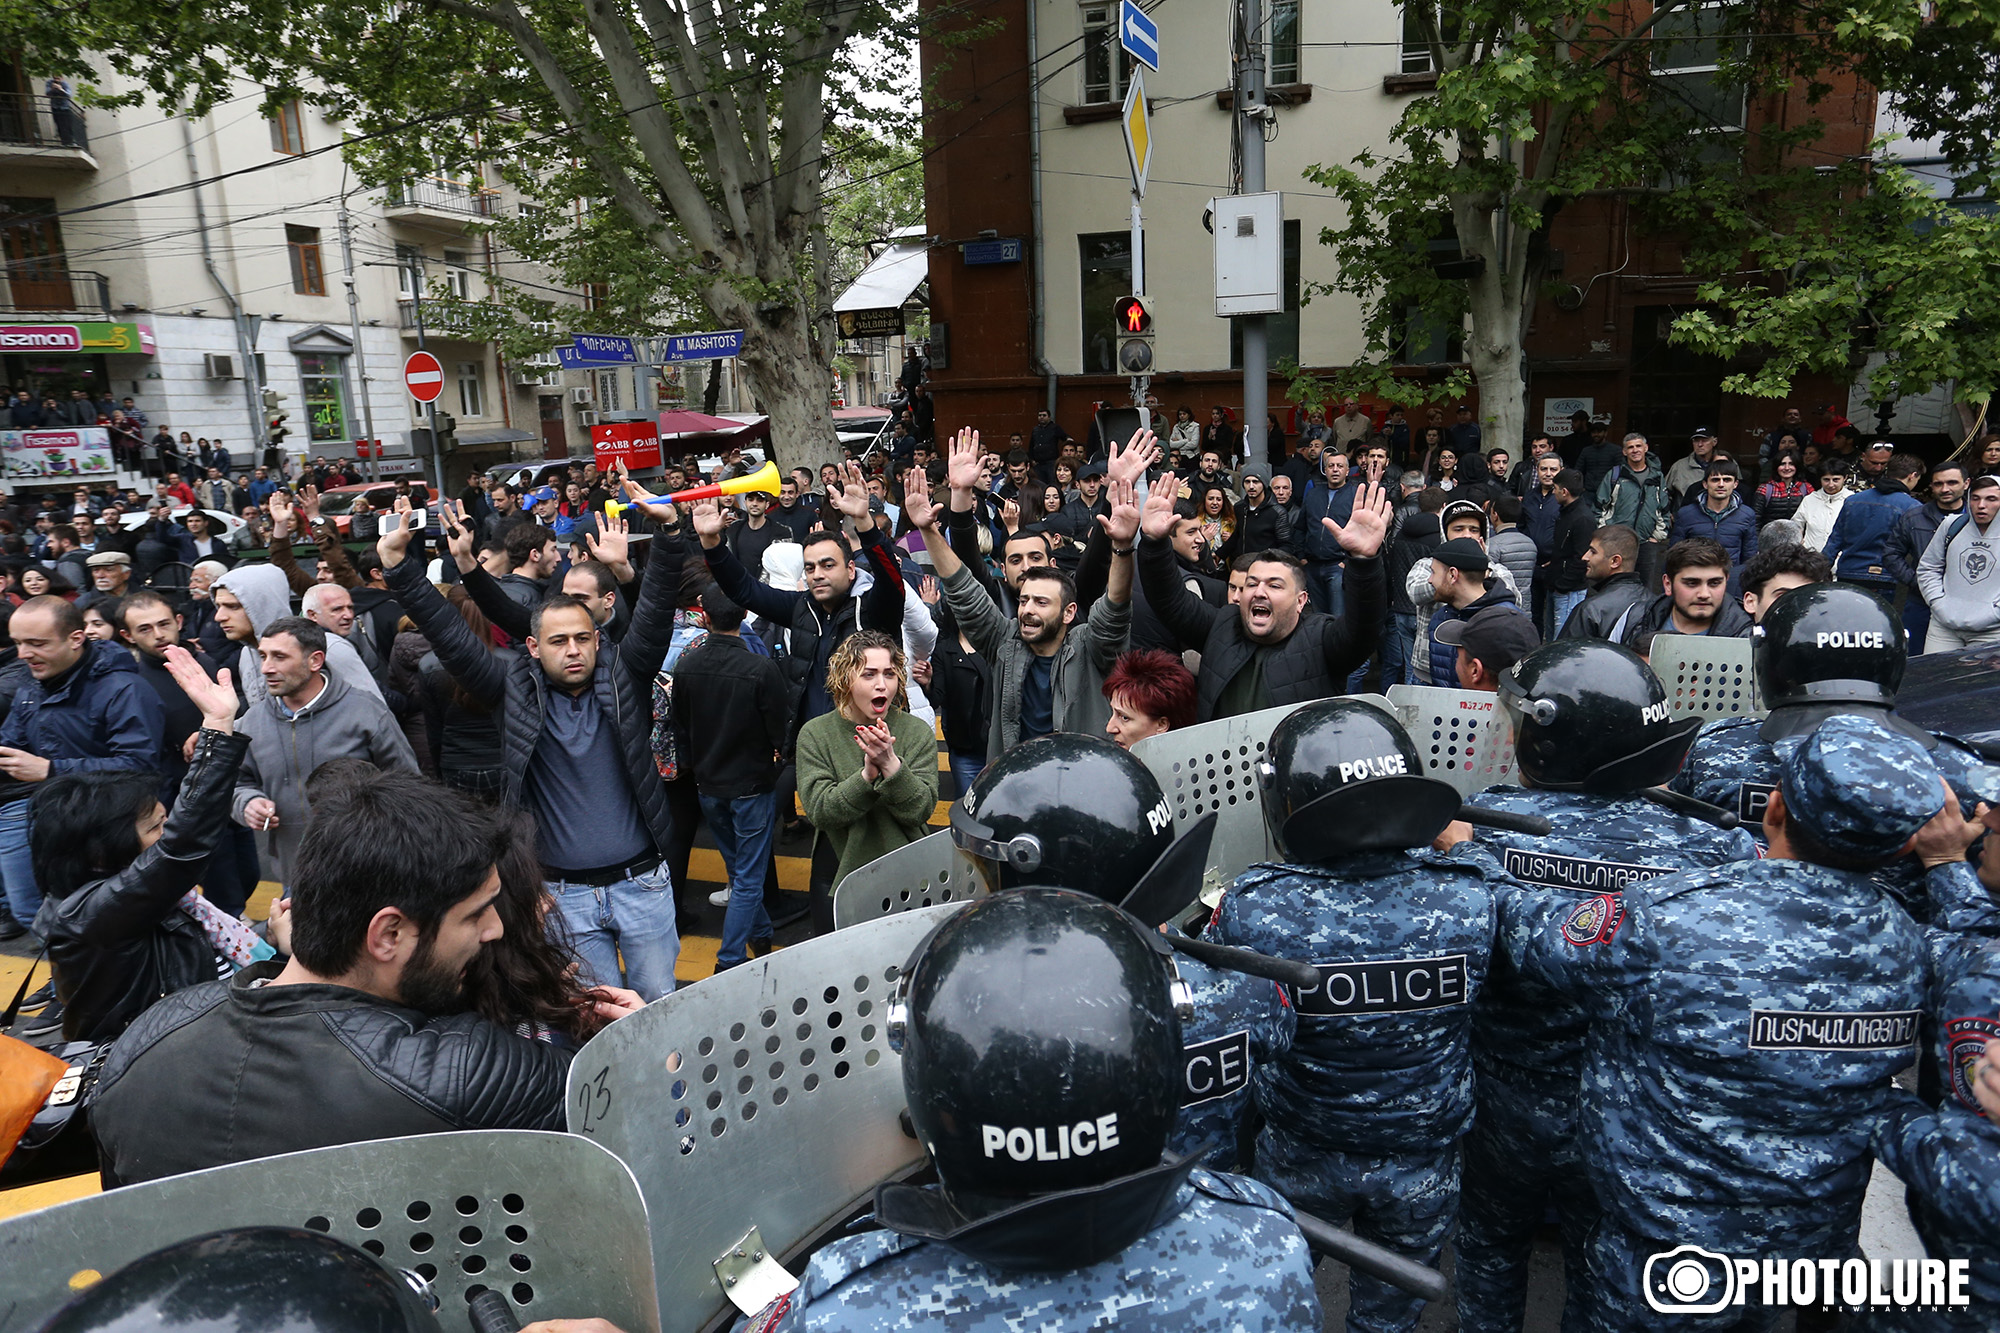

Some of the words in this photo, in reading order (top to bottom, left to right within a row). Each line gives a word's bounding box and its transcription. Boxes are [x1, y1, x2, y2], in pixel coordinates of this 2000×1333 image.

[1003, 245, 1015, 257] 27
[581, 337, 627, 352] ՊՈՒՇԿԻՆԻ
[676, 339, 687, 351] M.
[687, 335, 737, 350] MASHTOTS
[611, 440, 630, 450] ABB
[644, 437, 658, 447] ABB
[1817, 631, 1884, 649] POLICE
[1339, 753, 1408, 784] POLICE
[1607, 898, 1623, 934] POLICE
[1756, 1016, 1914, 1044] ՈՍՏԻԿԱՆՈՒԹՅՈՒՆ
[1954, 1021, 2000, 1037] POLIC
[579, 1066, 611, 1133] 23
[982, 1112, 1120, 1162] POLICE
